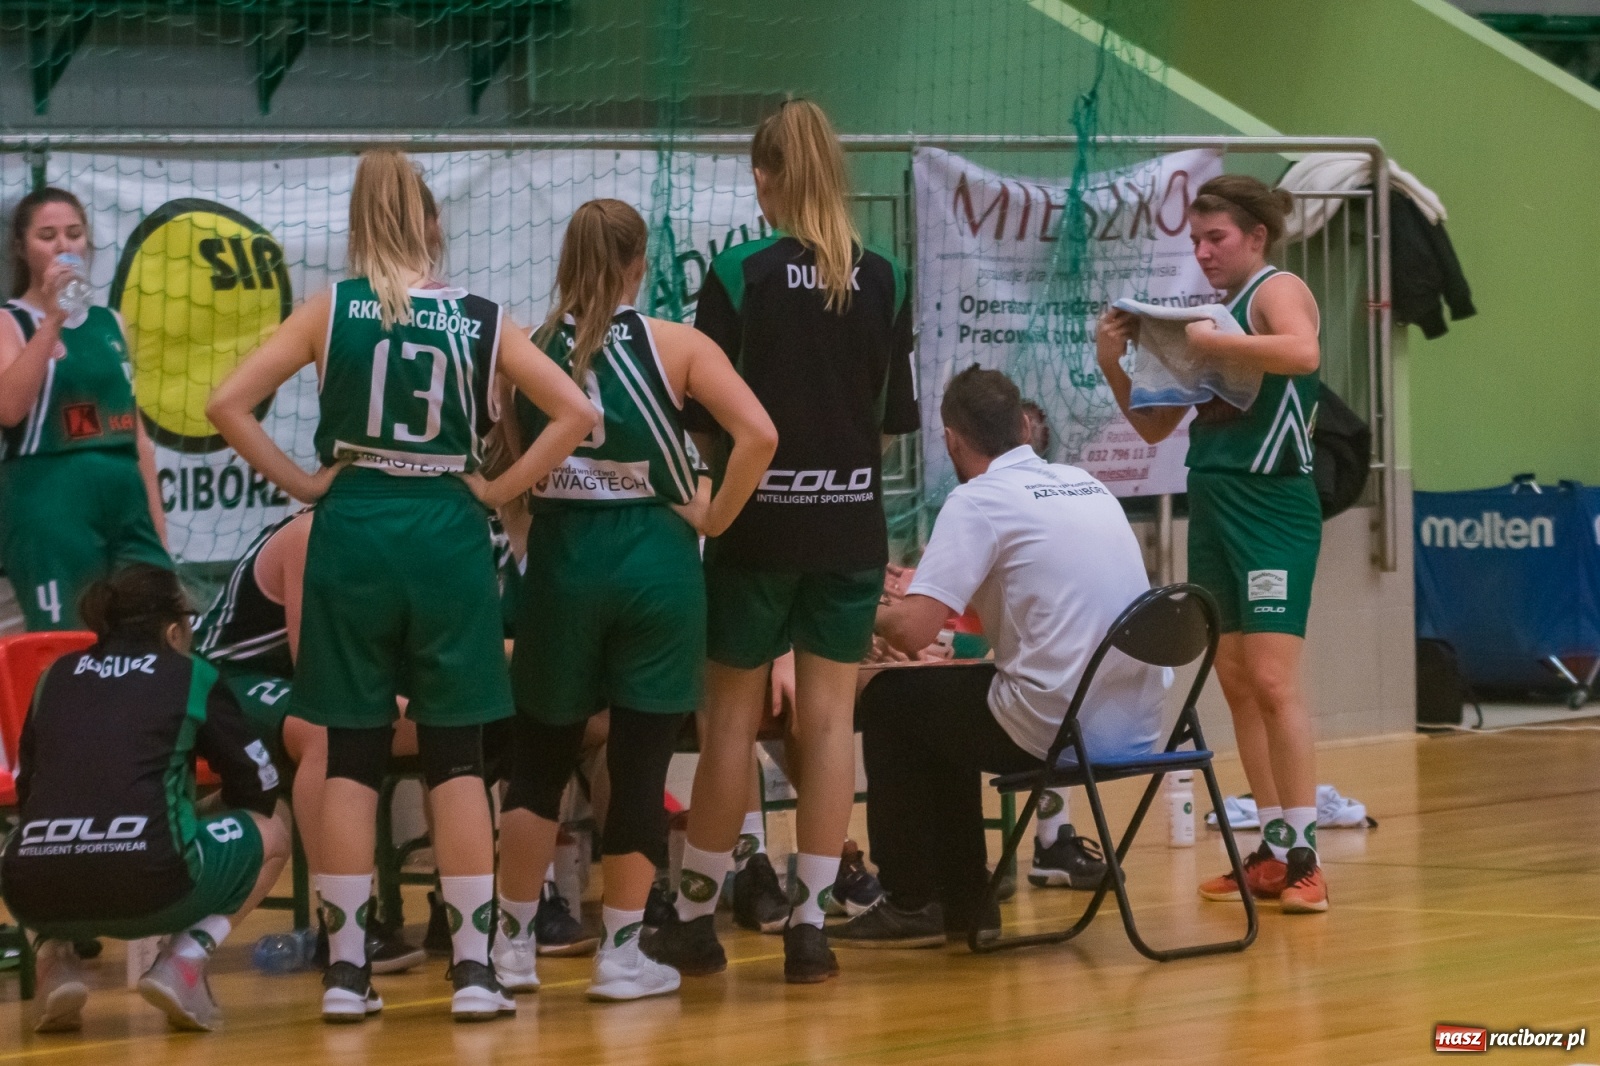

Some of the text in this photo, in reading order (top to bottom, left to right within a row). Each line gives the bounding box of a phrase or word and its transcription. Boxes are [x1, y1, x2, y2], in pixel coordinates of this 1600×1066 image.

[367, 338, 447, 443] 13
[552, 473, 648, 491] WAGTECH
[757, 468, 872, 491] COLO
[757, 492, 874, 504] INTELLIGENT SPORTSWEAR
[1421, 512, 1555, 549] molten
[37, 580, 61, 623] 4
[20, 816, 148, 846] COLO
[74, 841, 147, 854] SPORTSWEAR
